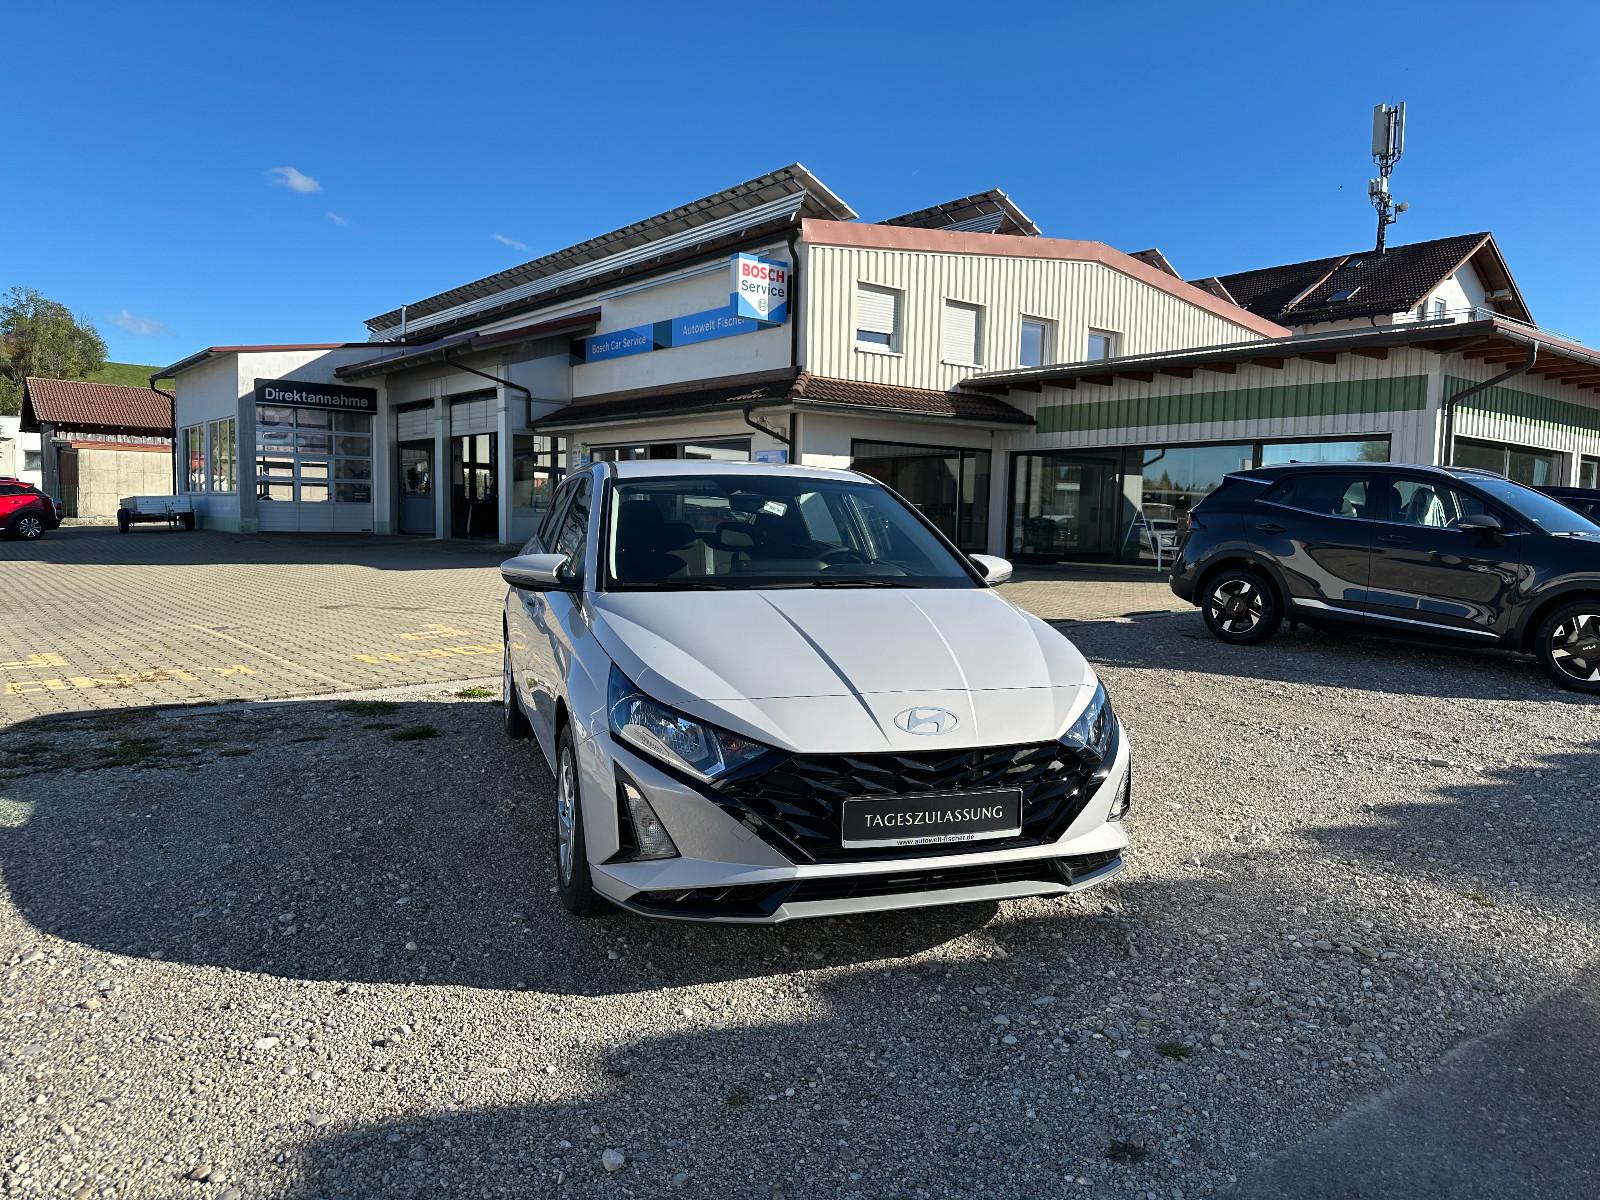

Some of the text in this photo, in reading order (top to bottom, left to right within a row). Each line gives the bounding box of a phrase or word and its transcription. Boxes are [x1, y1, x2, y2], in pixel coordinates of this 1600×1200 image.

[742, 263, 785, 284] BOSCH
[741, 279, 785, 298] Service
[682, 319, 715, 336] Autowelt
[591, 335, 647, 354] Bosch Car Service
[265, 387, 369, 408] Direktannahme
[865, 805, 1003, 828] TAGESZULASSUNG
[896, 833, 975, 846] www.autowelt-fischer.de
